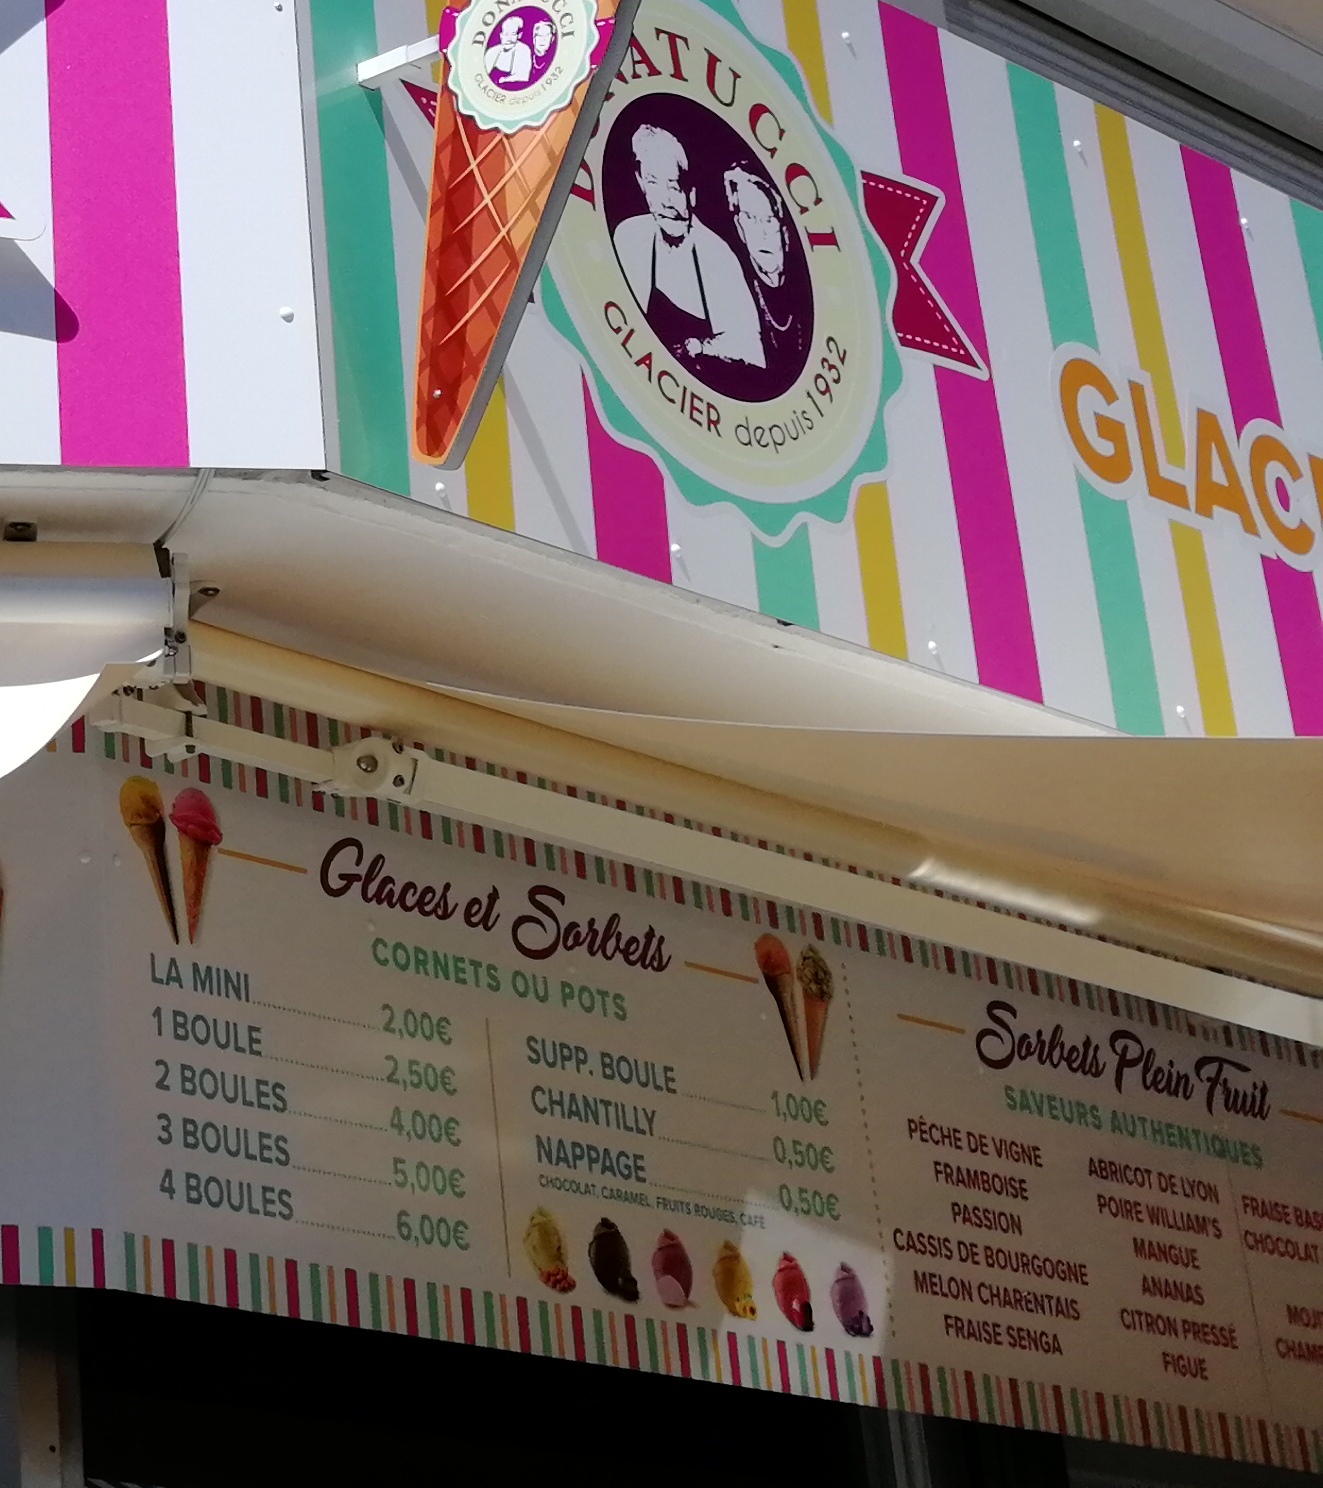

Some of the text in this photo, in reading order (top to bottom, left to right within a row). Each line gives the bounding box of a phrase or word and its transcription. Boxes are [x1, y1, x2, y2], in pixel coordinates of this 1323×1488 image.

[474, 73, 506, 105] GLACIER
[542, 66, 563, 92] 1932
[603, 301, 848, 455] GLACIER depuis 1932
[320, 837, 672, 972] Glaces et Sorbets
[150, 952, 453, 1045] LA MINI 2,00€
[371, 937, 628, 1022] CORNETS OU POTS
[152, 1006, 457, 1096] 1 BOULE 2,50€
[975, 1000, 1271, 1121] Sorbets Plein Fruit
[155, 1059, 462, 1147] 2 BOULES 4,00€
[526, 1035, 830, 1127] SUPP. BOULE 1,00€
[531, 1085, 835, 1174] CHANTILLY 0,50€
[907, 1115, 1043, 1168] PÊCHE DE VIGNE
[1004, 1084, 1264, 1170] SAVEURS AUTHENTIQUES
[157, 1113, 466, 1198] 3 BOULES 5,00€
[535, 1134, 842, 1222] NAPPAGE 0,50€
[933, 1160, 1029, 1201] FRAMBOISE
[1088, 1157, 1221, 1205] ABRICOT DE LYON
[159, 1168, 470, 1251] 4 BOULES 6,00€
[656, 1196, 692, 1216] FRUITS
[951, 1201, 1023, 1236] PASSION
[1097, 1193, 1223, 1240] POIRE WILLIAM'S
[1241, 1194, 1292, 1225] FRAISE
[893, 1228, 1090, 1287] CASSIS DE BOURGOGNE
[1133, 1236, 1201, 1271] MANGUE
[1243, 1229, 1320, 1264] CHOCOLAT
[913, 1269, 1081, 1321] MELON CHARENTAIS
[1141, 1274, 1205, 1306] ANANAS
[944, 1314, 1064, 1356] FRAISE SENGA
[1120, 1308, 1239, 1350] CITRON PRESSÉ
[1161, 1351, 1209, 1381] FIGUE
